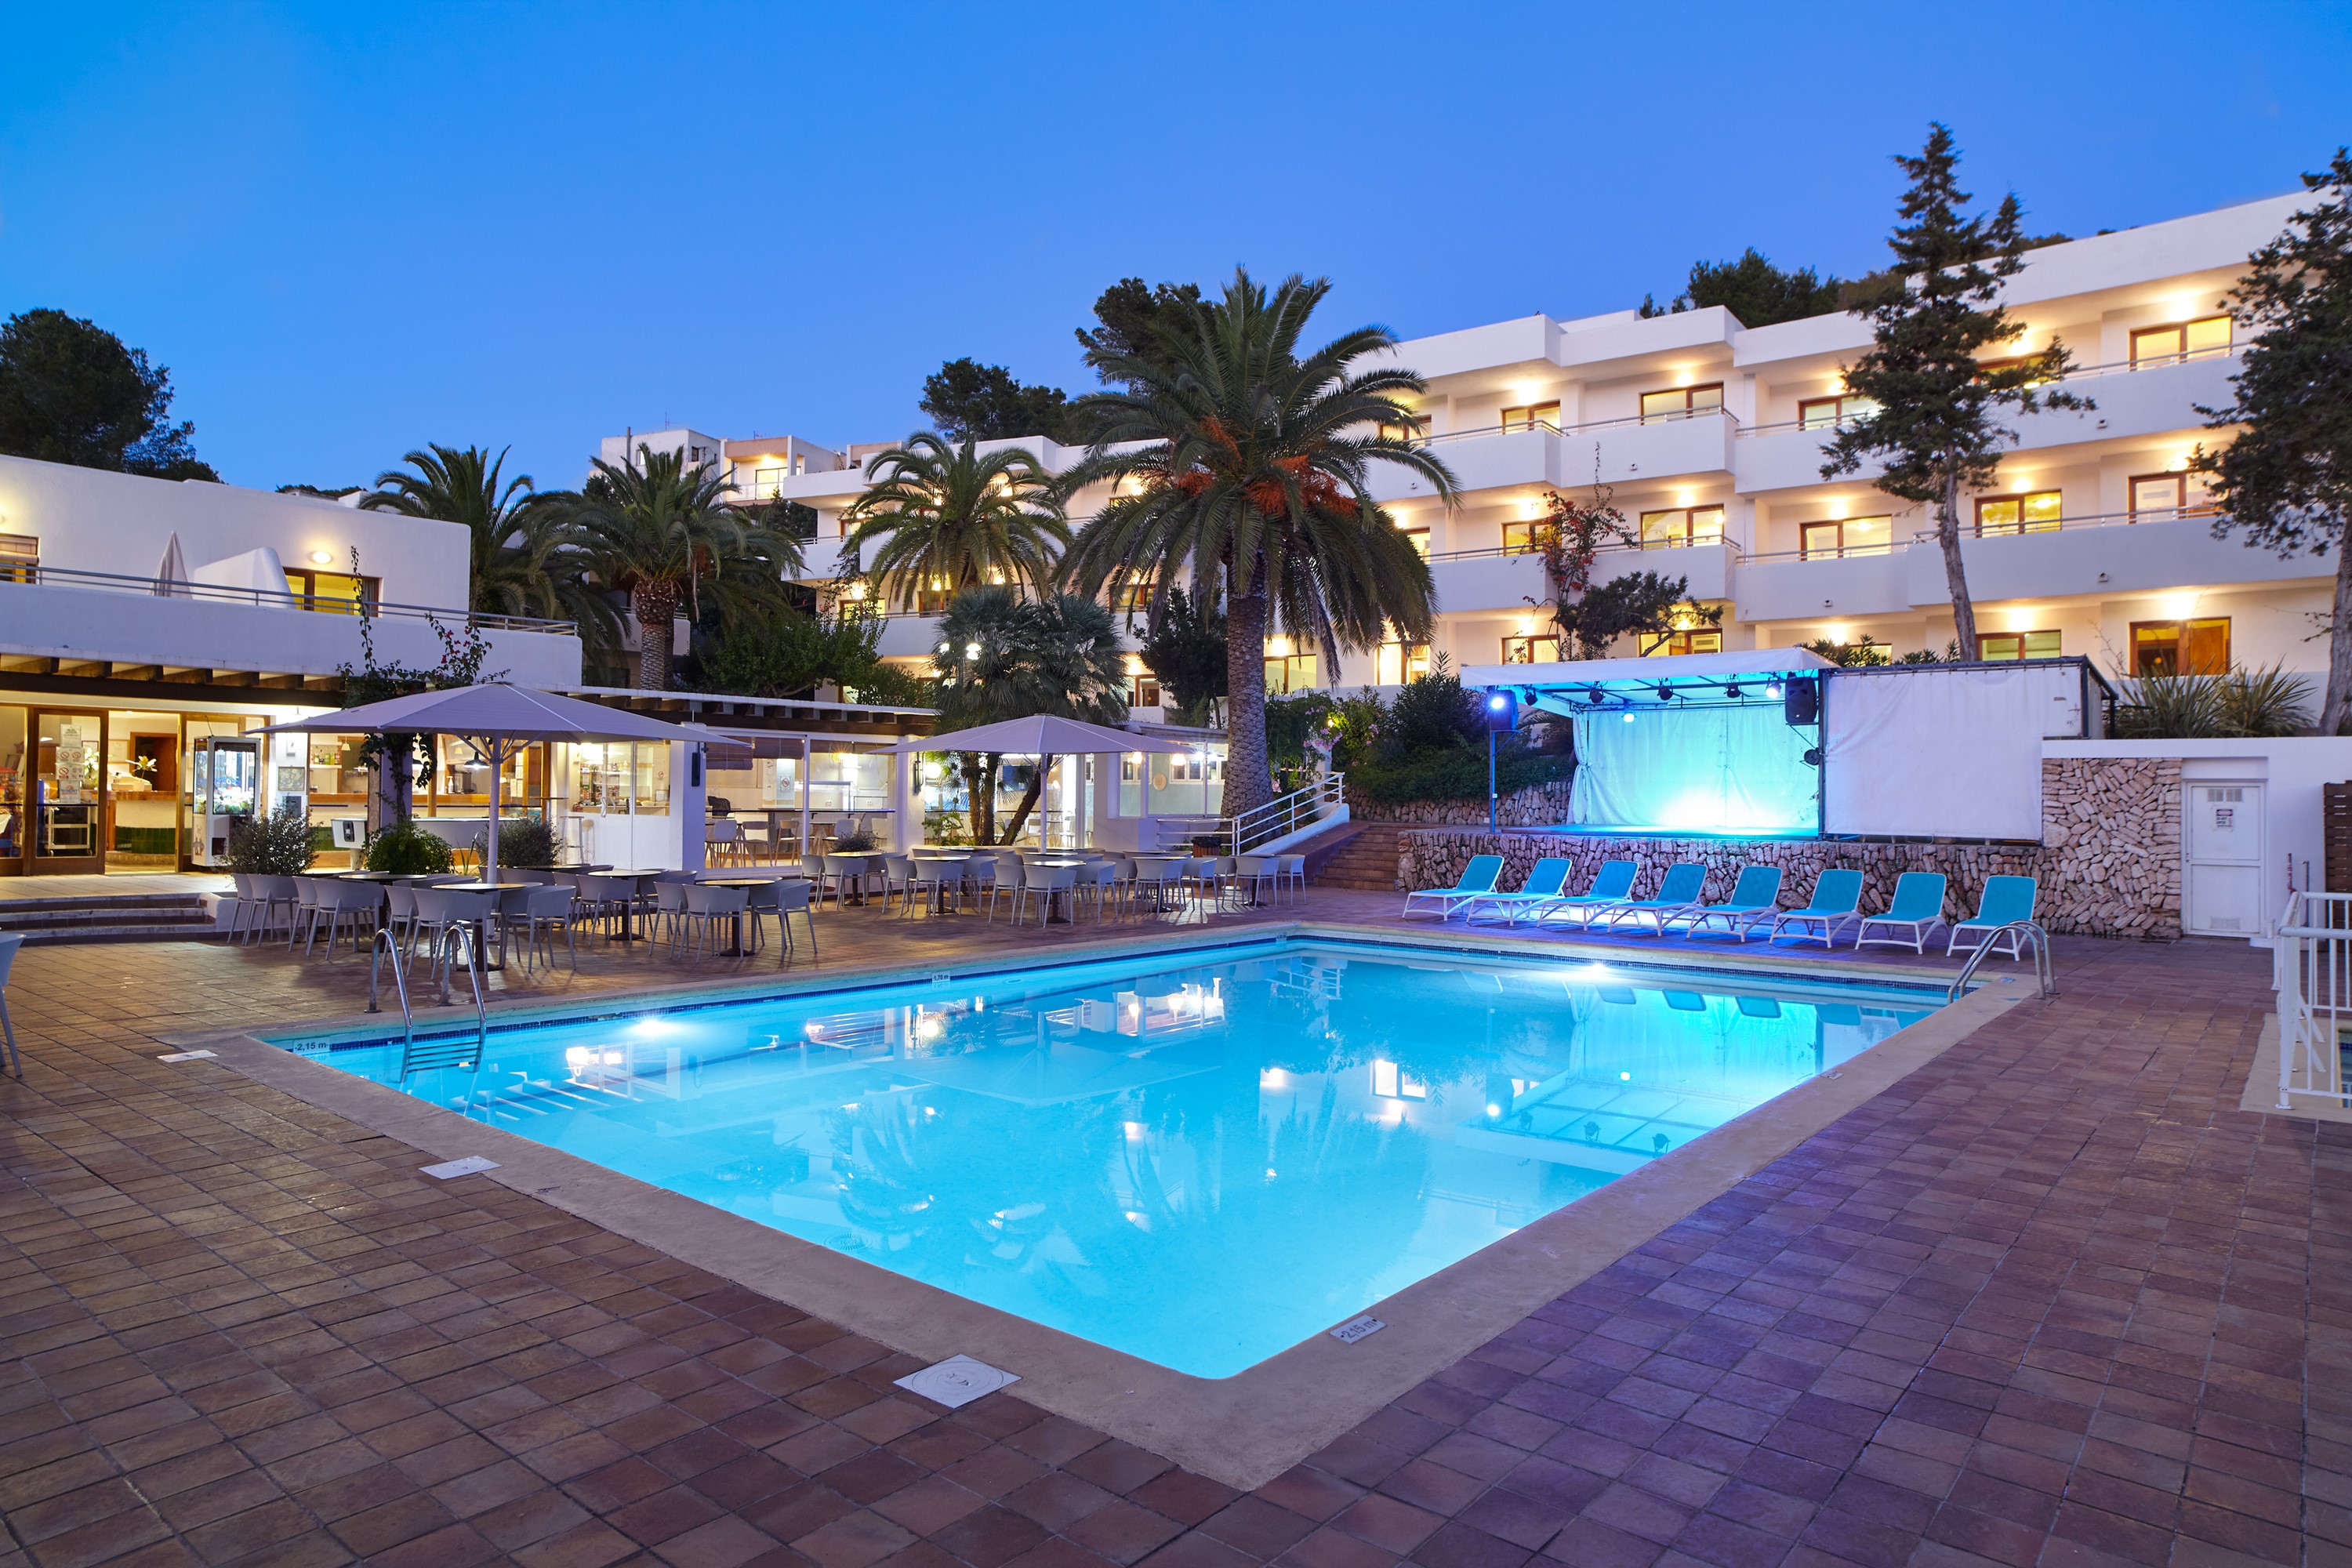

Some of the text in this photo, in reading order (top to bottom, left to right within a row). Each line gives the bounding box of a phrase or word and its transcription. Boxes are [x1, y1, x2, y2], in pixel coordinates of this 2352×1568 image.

[297, 1042, 316, 1051] 2,15
[1341, 1320, 1377, 1338] 2,15 m
